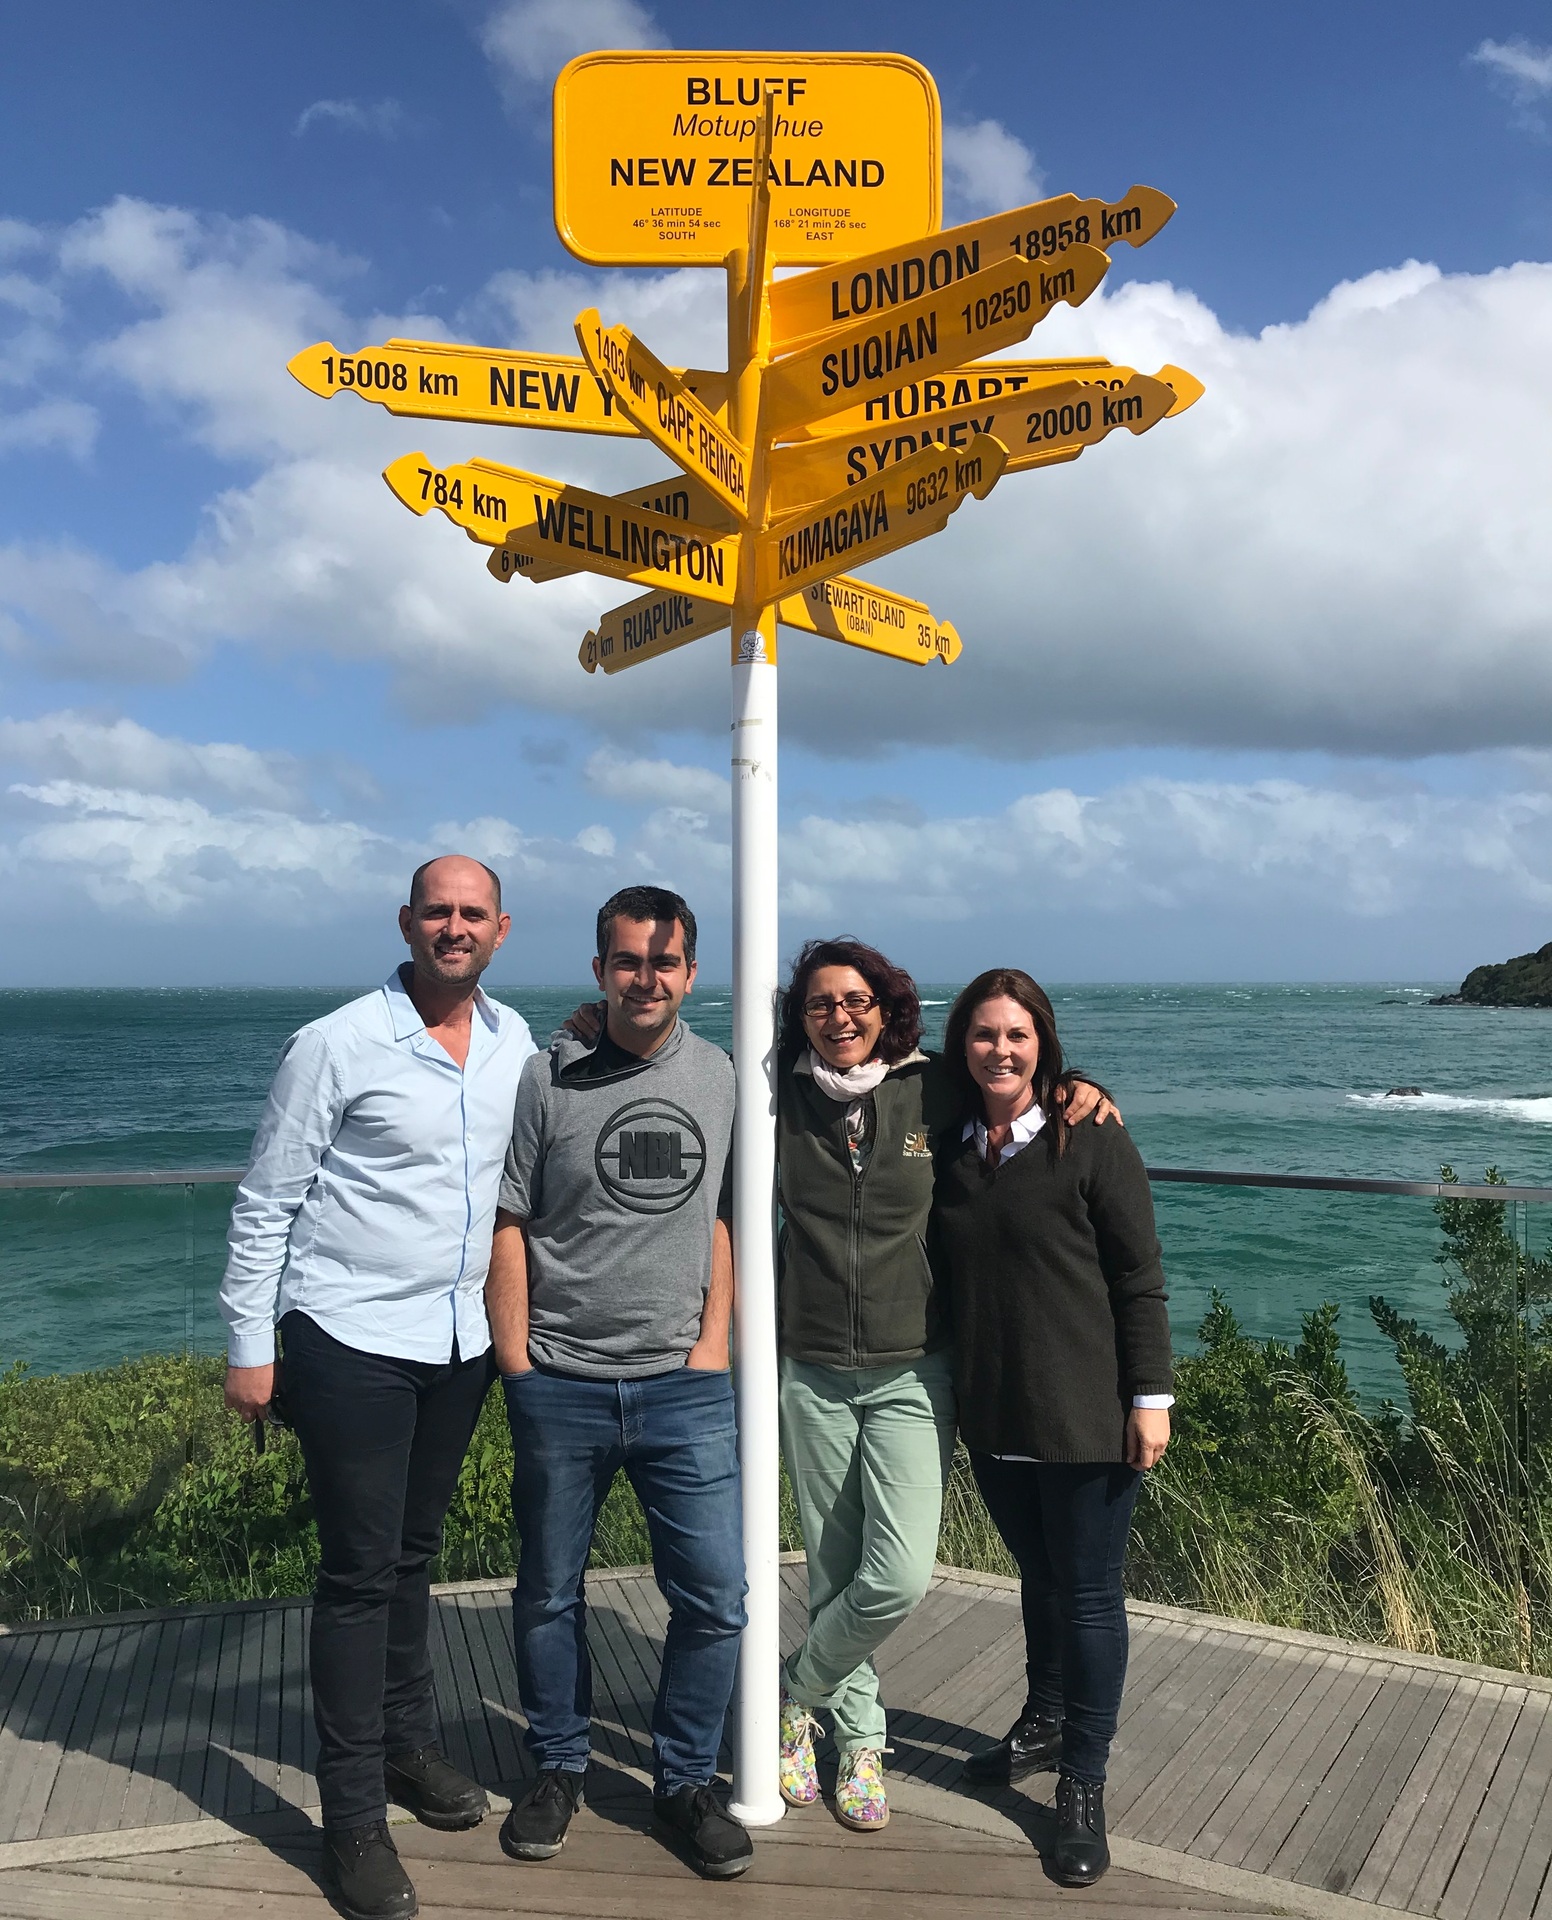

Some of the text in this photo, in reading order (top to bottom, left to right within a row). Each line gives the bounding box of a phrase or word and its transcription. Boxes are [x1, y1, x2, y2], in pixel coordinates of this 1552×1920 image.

[687, 77, 807, 106] BLUFF
[673, 113, 823, 142] Motuphue
[610, 158, 885, 187] NEW ZEALAND
[633, 218, 721, 228] 46° 36 min 54 sec
[651, 207, 702, 217] LATITUDE
[773, 219, 867, 229] 168° 21 min 26 sec
[789, 208, 851, 217] LONGITUDE
[658, 232, 696, 240] SOUTH
[806, 232, 834, 240] EAST
[831, 206, 1141, 321] LONDON 18958 km
[821, 268, 1075, 397] SUQIAN 10250 km
[321, 356, 408, 391] 15008
[419, 365, 459, 396] km
[489, 366, 581, 414] NEW
[865, 376, 1029, 421] HOBART
[595, 326, 625, 382] 1403
[629, 358, 646, 404] km
[657, 381, 695, 456] CAPE
[699, 421, 745, 503] REINGA
[1026, 400, 1091, 443] 2000
[1102, 394, 1143, 427] km
[417, 468, 464, 510] 784
[473, 485, 508, 523] km
[534, 494, 724, 587] WELLINGTON
[778, 456, 982, 580] KUMAGAYA 9632 km
[501, 550, 510, 573] 6
[811, 582, 905, 630] STEWART ISLAND
[587, 595, 694, 664] 21 km RUAPUKE
[846, 613, 874, 637] (OBAN)
[917, 623, 951, 655] 35 km
[618, 1131, 687, 1180] NBL
